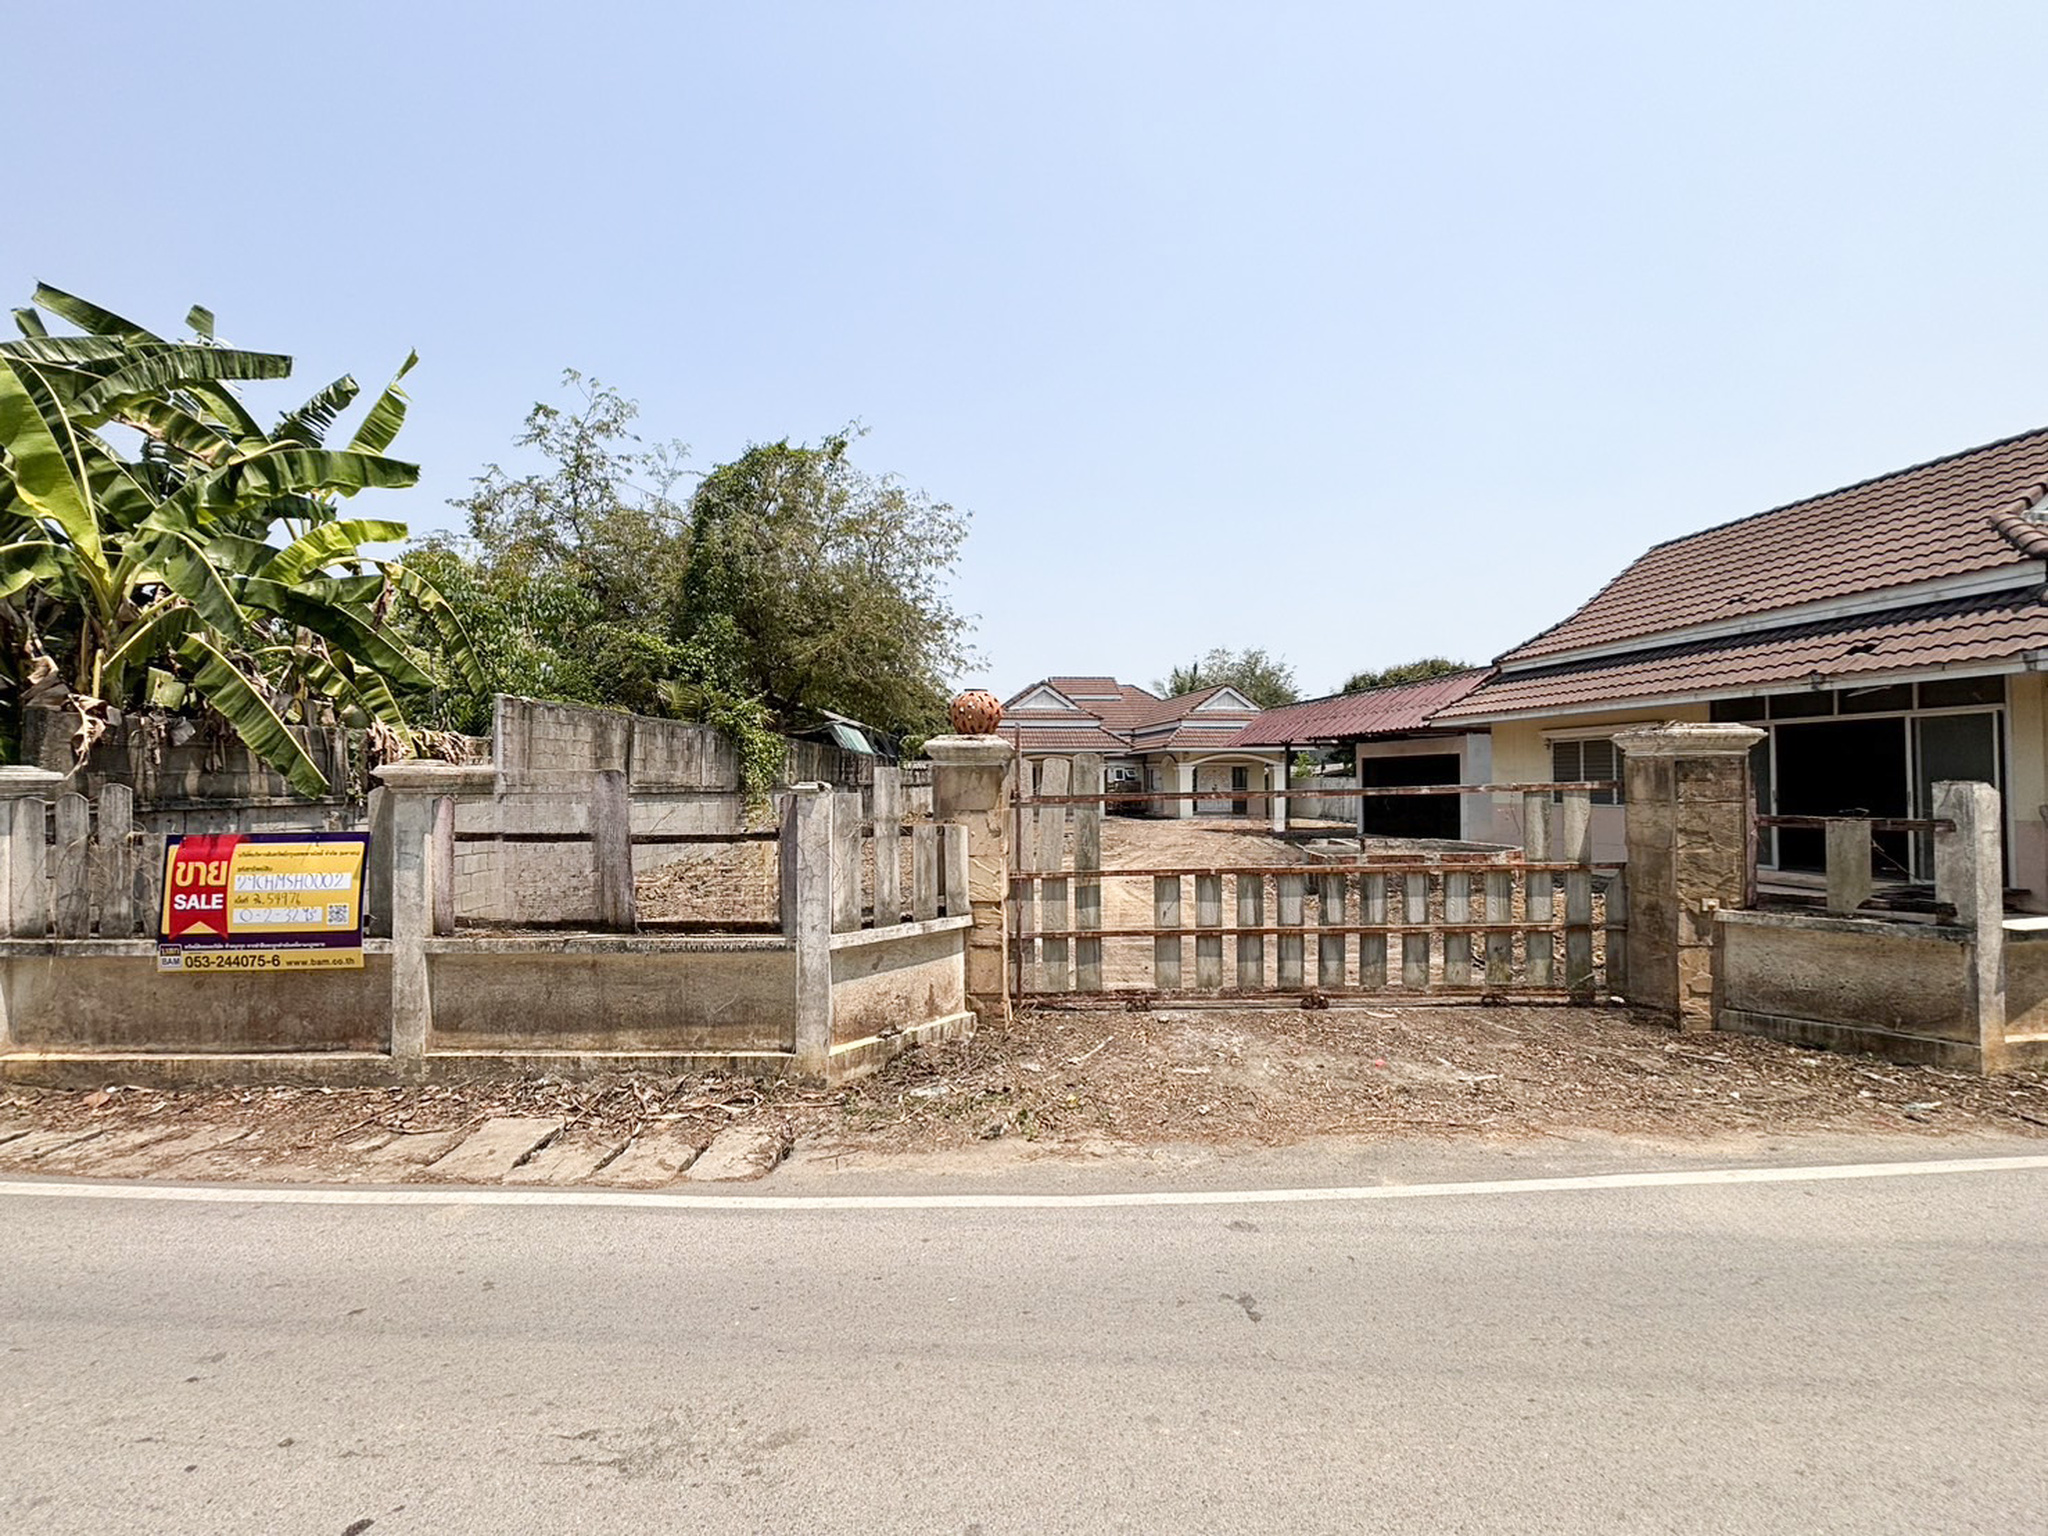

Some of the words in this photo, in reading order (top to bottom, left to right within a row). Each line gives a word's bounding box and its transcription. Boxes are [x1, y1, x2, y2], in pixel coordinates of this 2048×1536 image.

[175, 860, 228, 887] ขาย
[173, 893, 224, 911] SALE
[161, 957, 180, 966] BAM
[185, 955, 281, 968] 053-244075-6
[286, 957, 355, 967] www.bam.co.th
